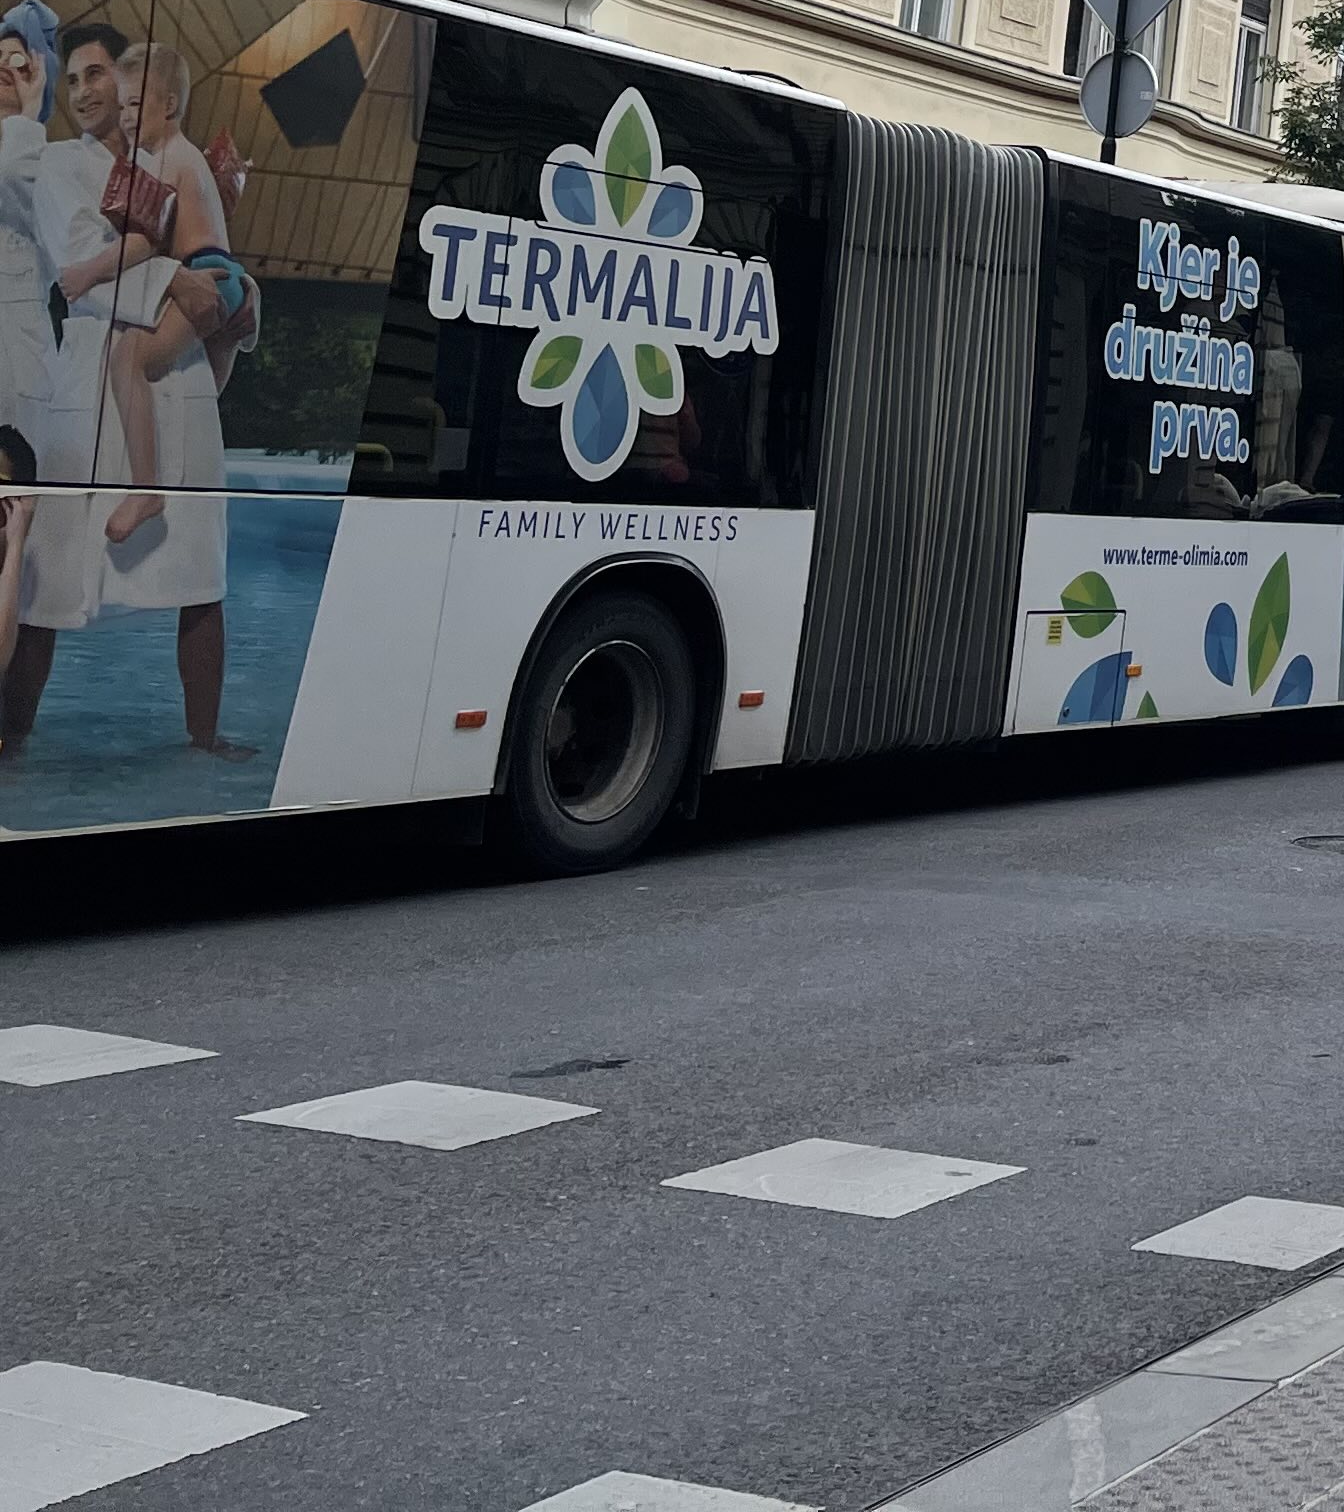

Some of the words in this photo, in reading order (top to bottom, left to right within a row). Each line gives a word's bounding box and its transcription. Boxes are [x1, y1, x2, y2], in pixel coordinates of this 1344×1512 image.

[432, 223, 771, 343] TERMALIJA
[1136, 217, 1220, 312] Kjer
[1220, 235, 1260, 323] je
[1104, 302, 1254, 396] družina
[1149, 400, 1250, 475] prva.
[478, 509, 587, 539] FAMILY
[599, 512, 739, 542] WELLNESS
[1103, 544, 1249, 567] www.terme-olimia.com
